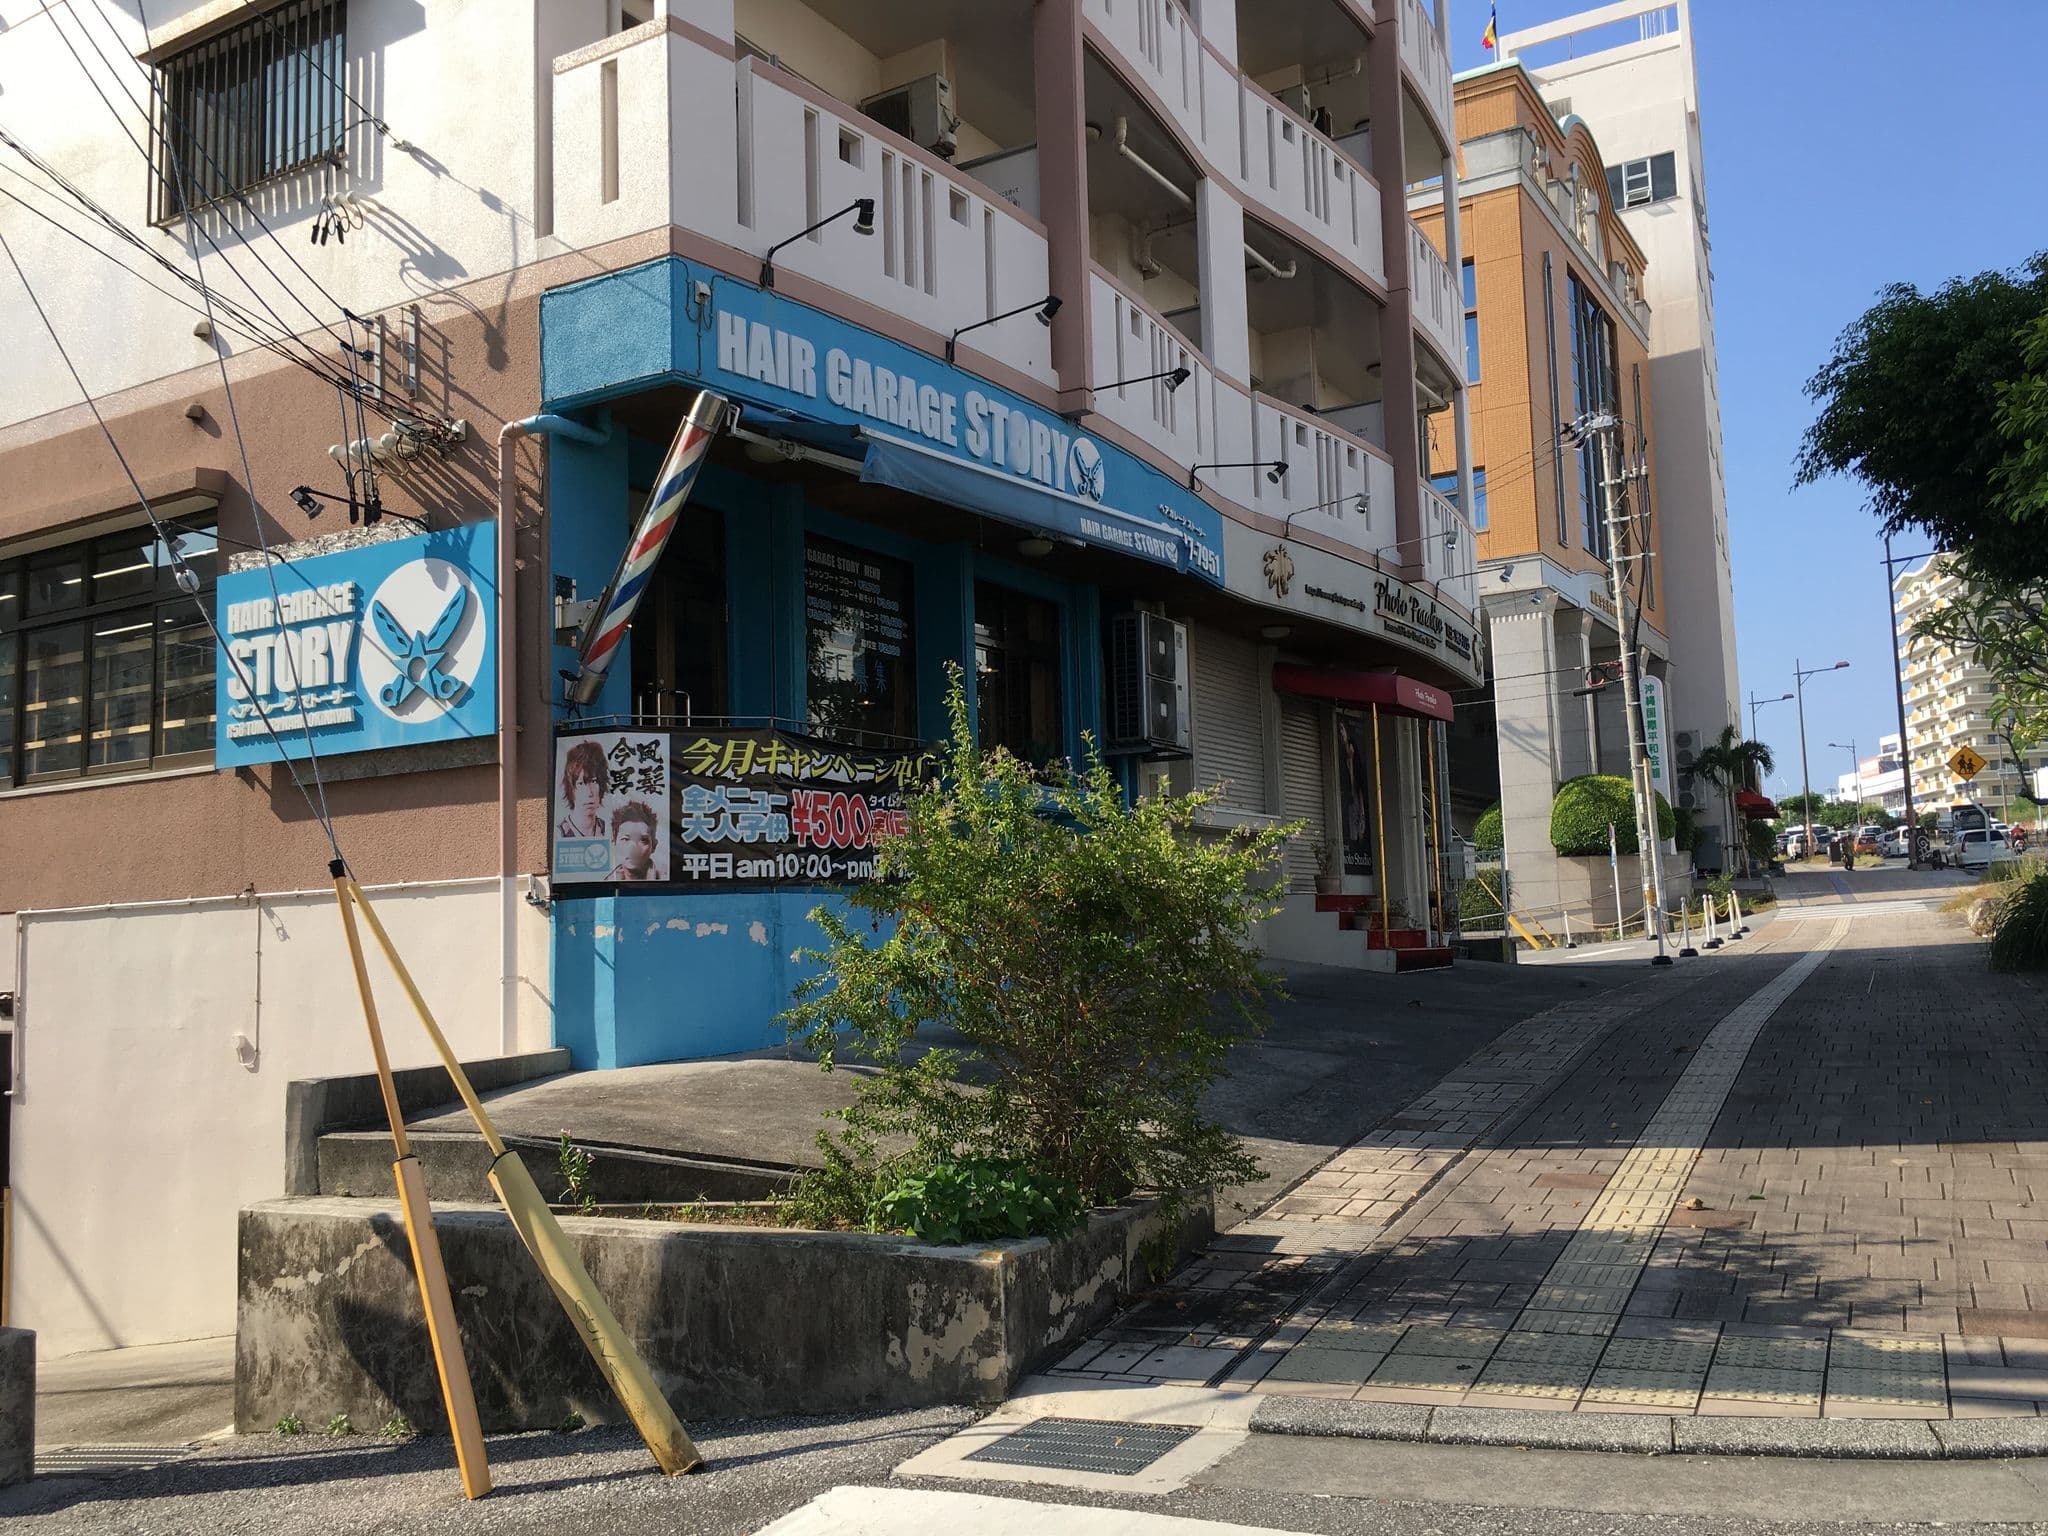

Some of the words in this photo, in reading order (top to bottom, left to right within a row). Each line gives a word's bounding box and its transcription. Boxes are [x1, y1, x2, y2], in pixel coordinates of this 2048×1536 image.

[718, 310, 817, 398] HAIR
[825, 347, 957, 448] GARAGE
[963, 389, 1070, 490] STORY
[1080, 517, 1101, 539] HAIR
[1101, 524, 1133, 548] GARAGE
[1133, 531, 1166, 559] STORY
[228, 598, 274, 634] HAIR
[275, 581, 356, 626] GARAGE
[1374, 578, 1408, 617] Photo
[227, 620, 356, 700] STORY
[681, 785, 788, 815] 全メニュー
[791, 789, 872, 849] ¥500
[681, 813, 790, 844] 大人子供
